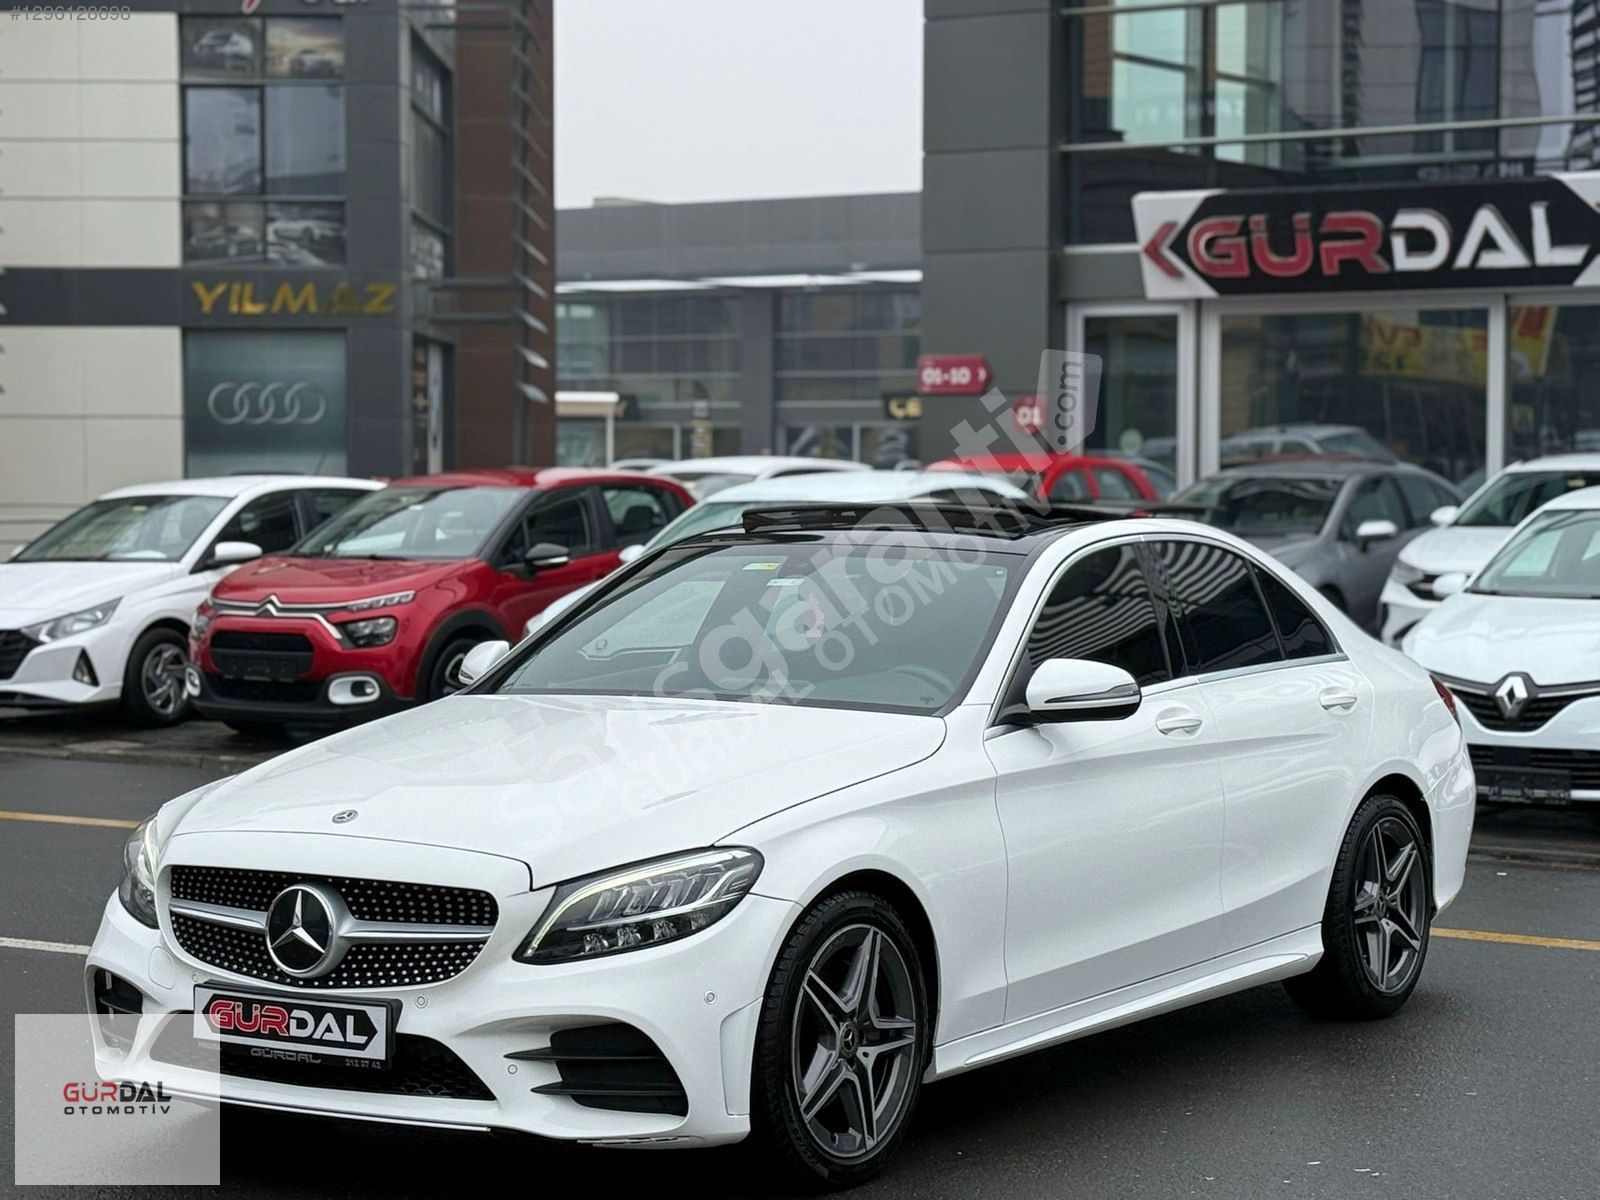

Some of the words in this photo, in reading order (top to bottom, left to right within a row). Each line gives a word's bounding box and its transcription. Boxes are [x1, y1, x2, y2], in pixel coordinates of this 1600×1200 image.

[191, 280, 399, 317] YILMAZ
[920, 366, 972, 386] 01-10
[1015, 406, 1043, 426] 01
